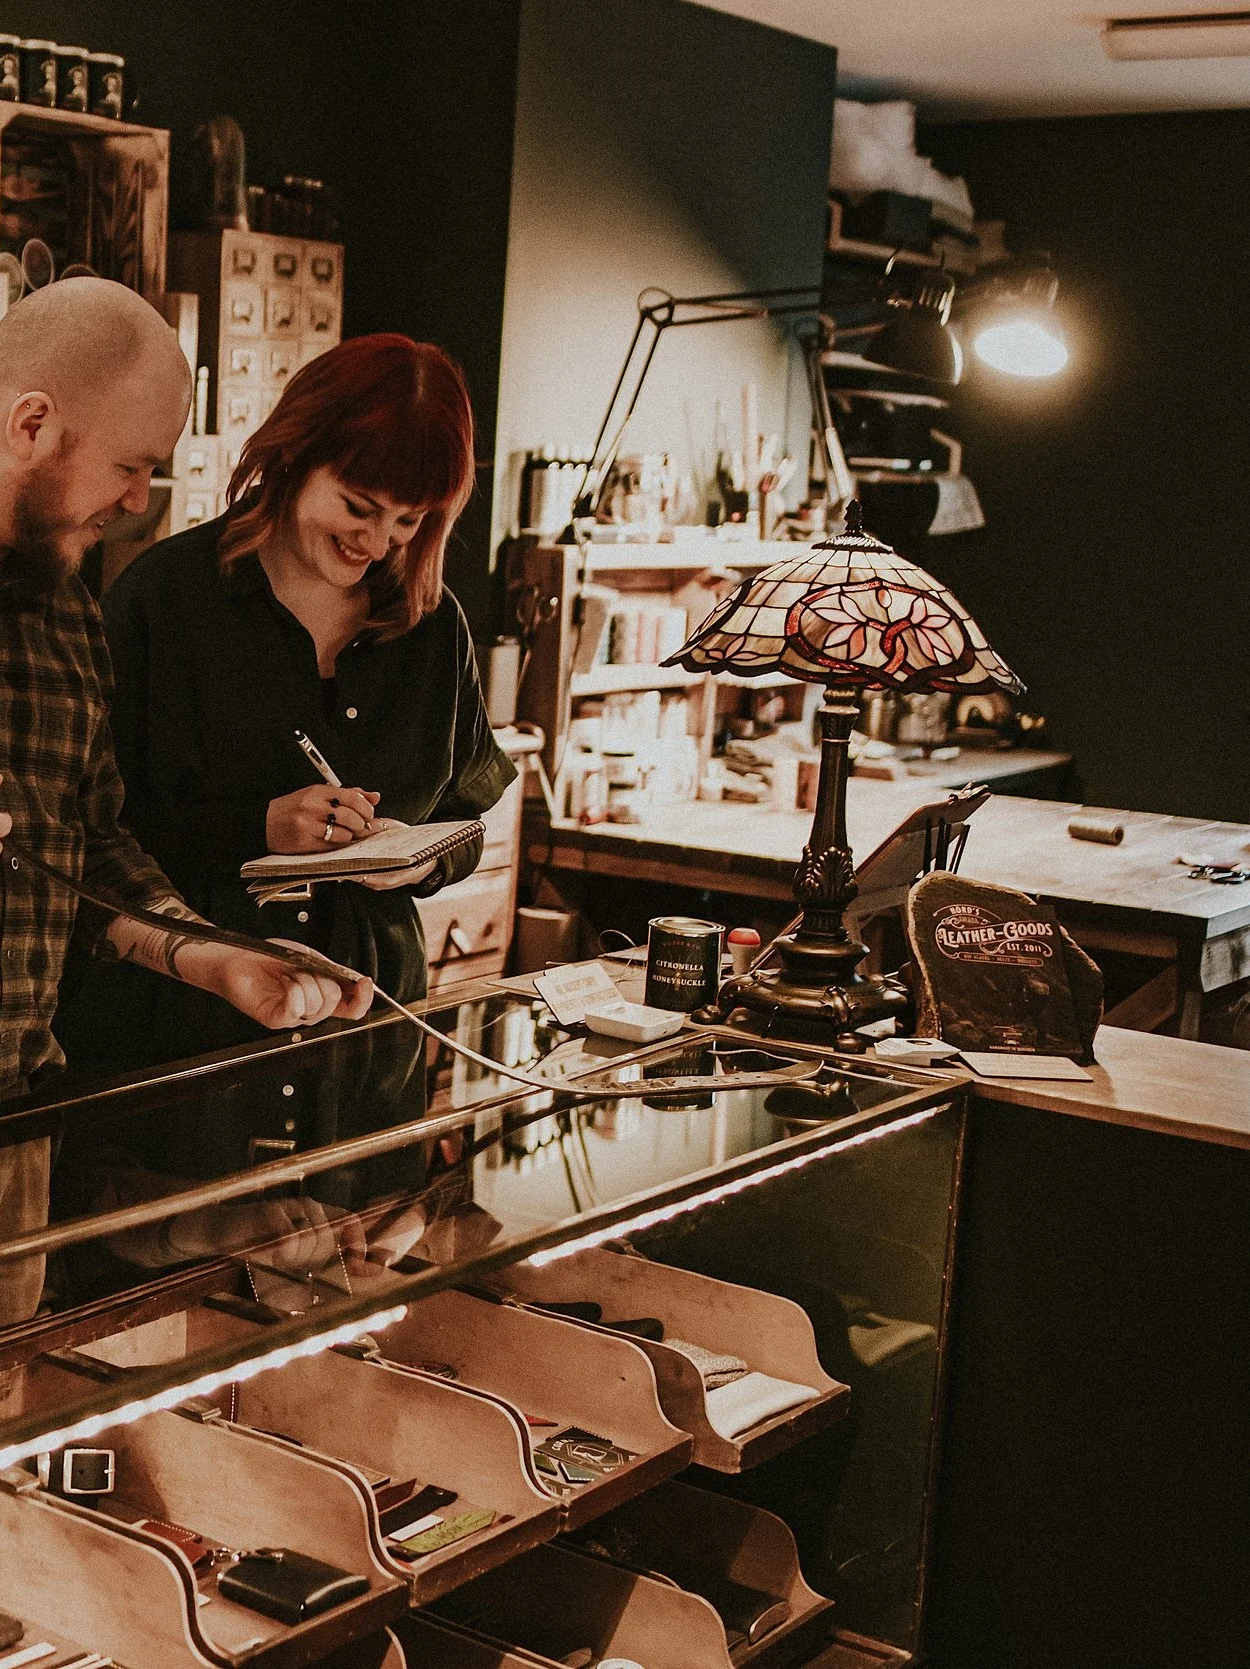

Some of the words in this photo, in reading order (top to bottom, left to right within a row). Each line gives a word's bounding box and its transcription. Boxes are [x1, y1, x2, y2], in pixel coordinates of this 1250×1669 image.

[937, 921, 1054, 949] LEATHER-GOODS
[655, 959, 704, 971] CITRONELLA
[652, 974, 706, 986] HONEYSUCKLE
